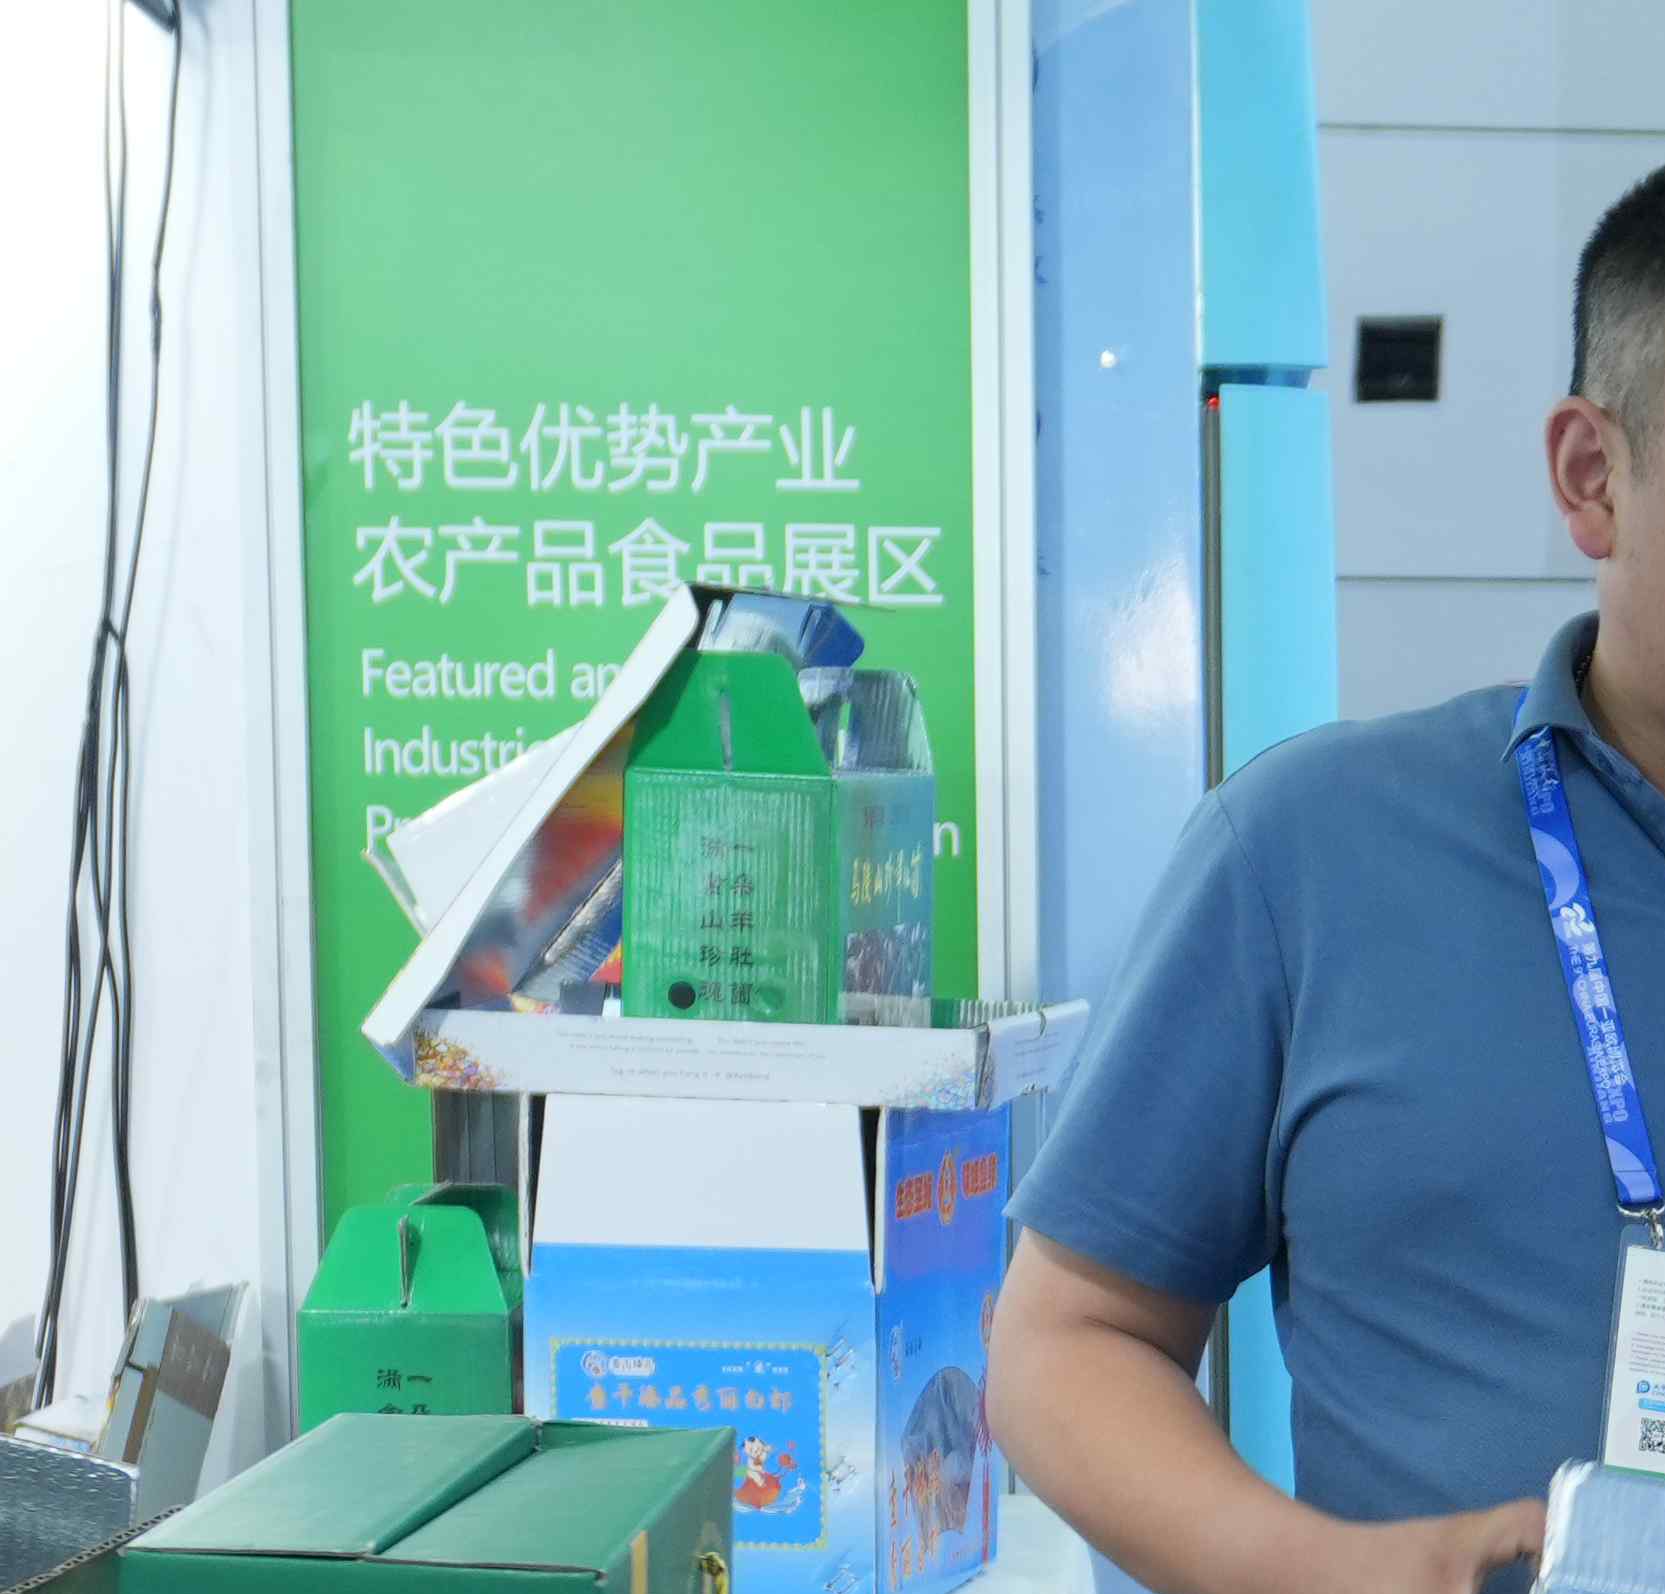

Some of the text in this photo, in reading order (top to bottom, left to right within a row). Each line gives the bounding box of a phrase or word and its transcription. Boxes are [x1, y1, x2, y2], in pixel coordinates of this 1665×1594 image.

[347, 400, 862, 493] 特色优势产业
[352, 517, 945, 607] 农产品食品展区
[361, 648, 625, 698] Featured an
